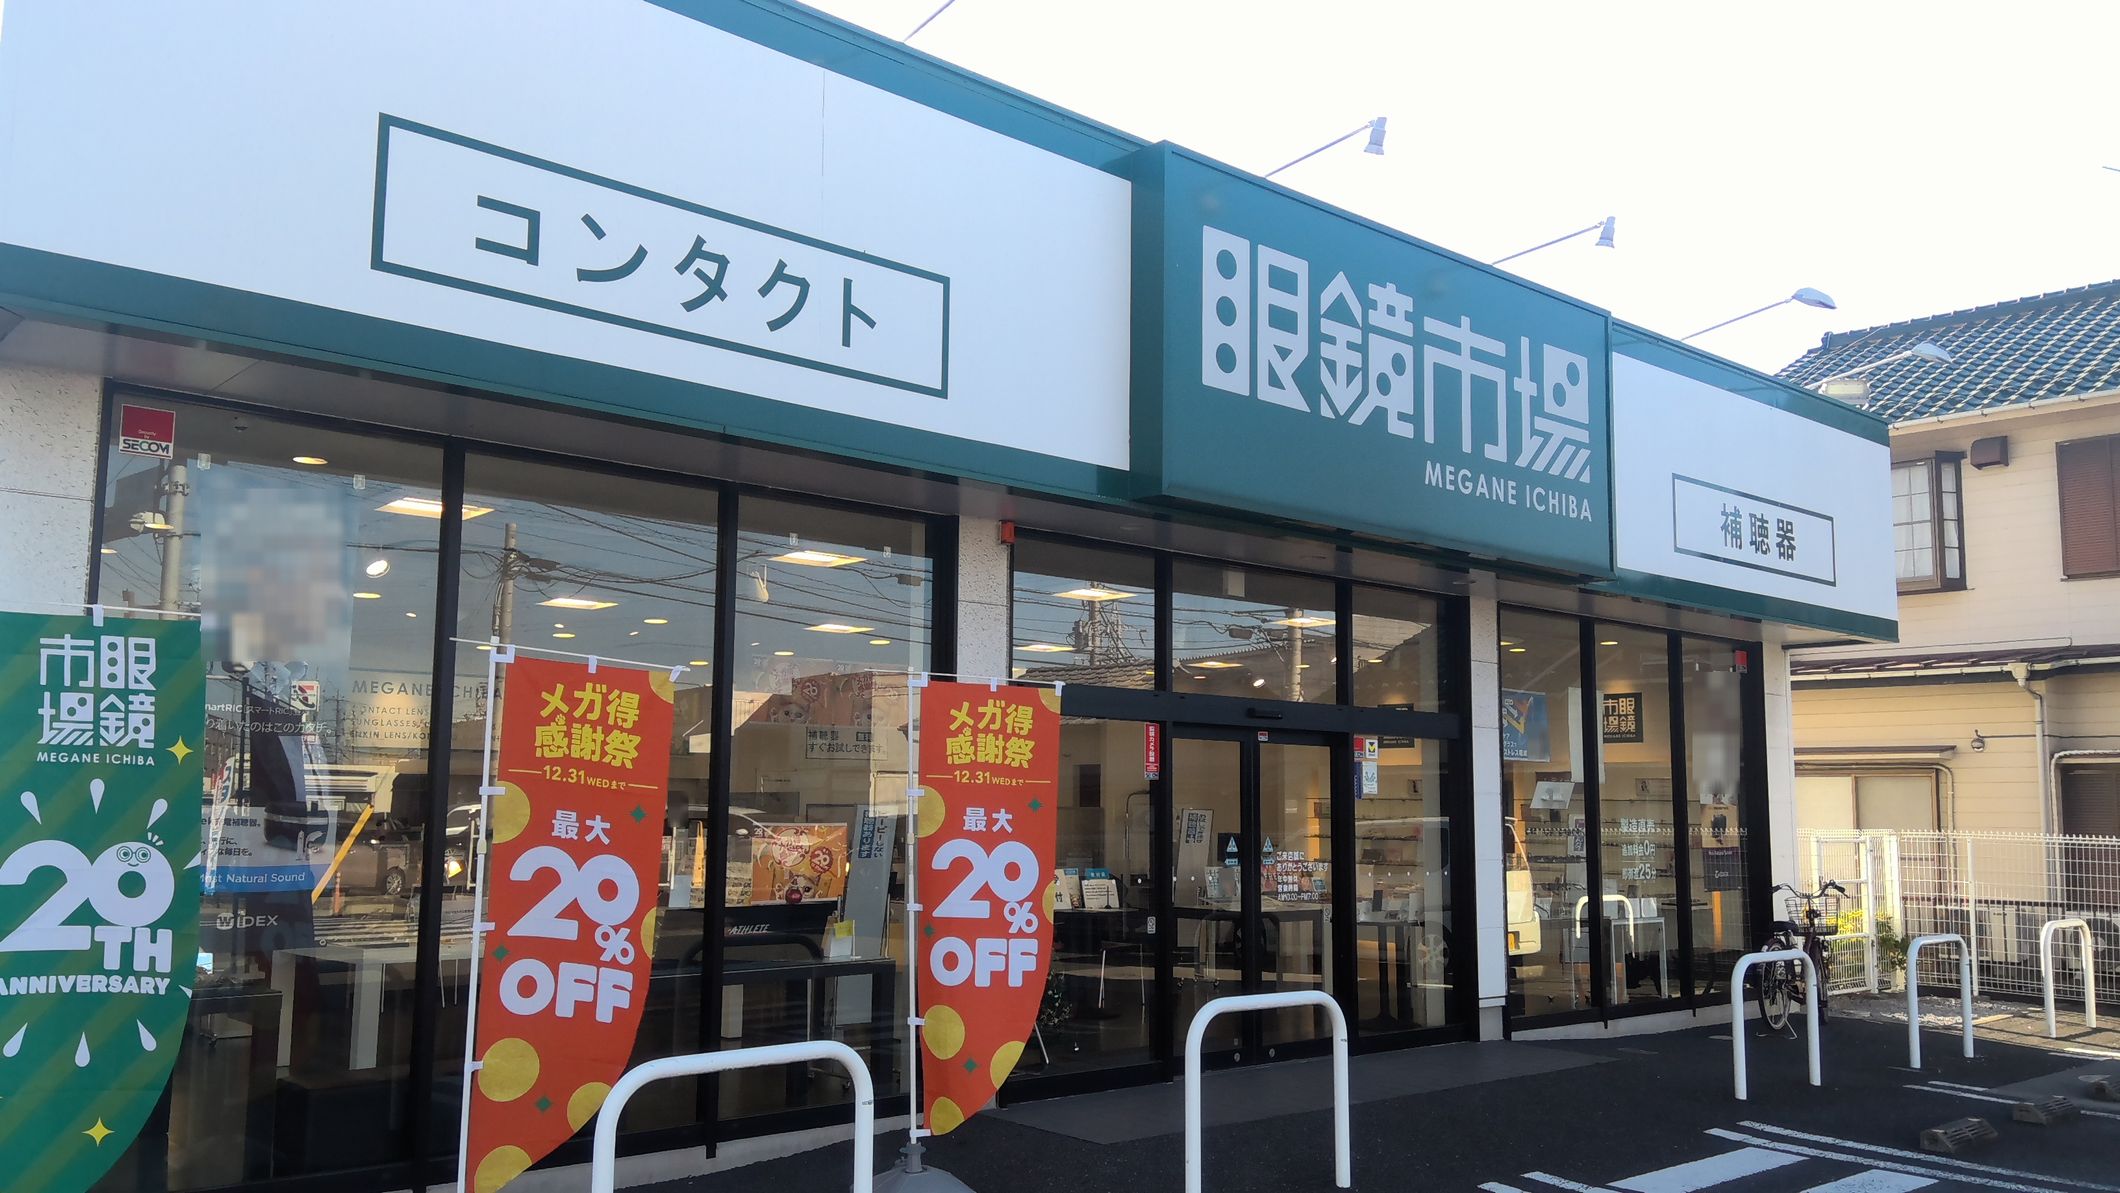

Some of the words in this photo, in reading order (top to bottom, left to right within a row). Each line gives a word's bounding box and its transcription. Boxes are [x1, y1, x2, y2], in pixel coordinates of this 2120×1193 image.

[475, 194, 877, 348] コンタクト
[1202, 225, 1592, 484] 眼鏡市場
[122, 438, 170, 455] SECOM
[1425, 460, 1517, 506] MEGANE
[1525, 485, 1592, 522] ICHIBA
[1720, 502, 1797, 562] 補聴器
[540, 682, 641, 729] メガ得
[948, 699, 1034, 736] メガ得
[36, 751, 100, 763] MEGANE
[105, 753, 155, 766] ICHIBA
[534, 722, 642, 769] 感謝祭
[945, 731, 1036, 769] 感謝祭
[551, 809, 612, 846] 最大
[962, 807, 1014, 834] 最大
[226, 873, 268, 884] Natural
[270, 871, 306, 883] Sound
[929, 936, 1039, 988] OFF
[499, 958, 634, 1024] OFF
